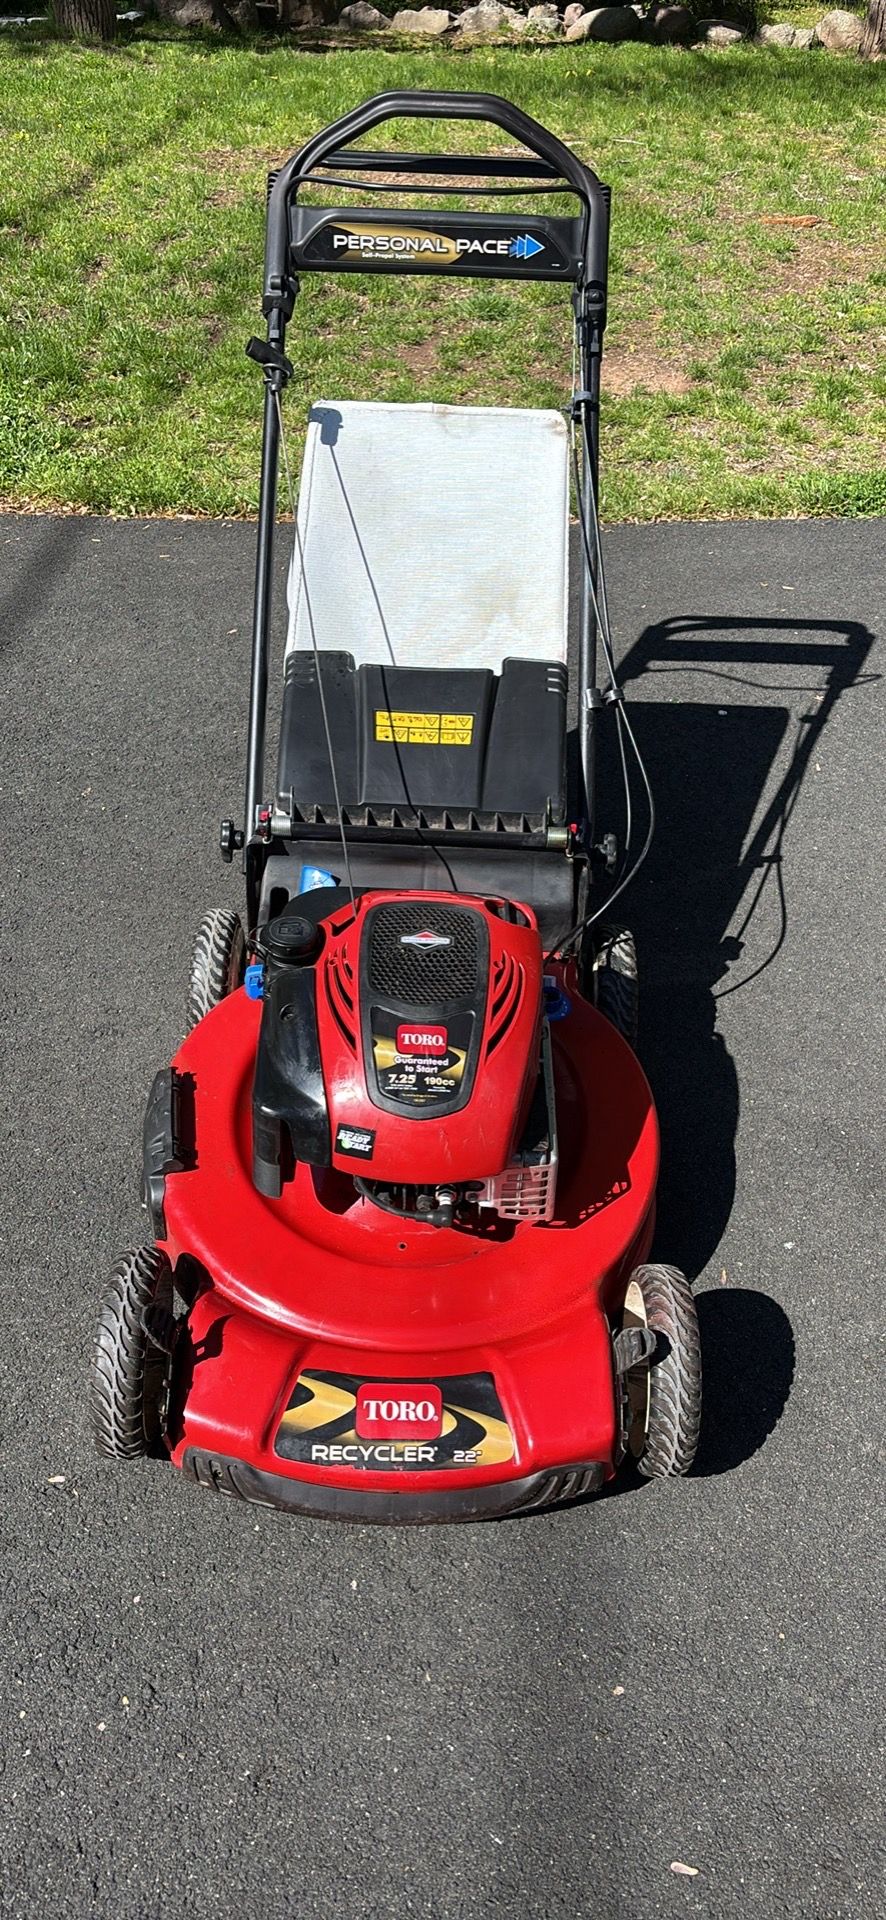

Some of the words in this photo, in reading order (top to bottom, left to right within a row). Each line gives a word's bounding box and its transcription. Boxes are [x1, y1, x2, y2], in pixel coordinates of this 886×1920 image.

[333, 234, 449, 254] PERSONAL
[456, 238, 512, 255] PACE
[401, 1033, 443, 1046] TORO
[394, 1056, 449, 1066] Guaranteed
[405, 1065, 414, 1073] to
[416, 1065, 438, 1073] Start
[388, 1073, 416, 1084] 7.25
[424, 1077, 455, 1086] 190cc
[311, 1445, 435, 1462] RECYCLER
